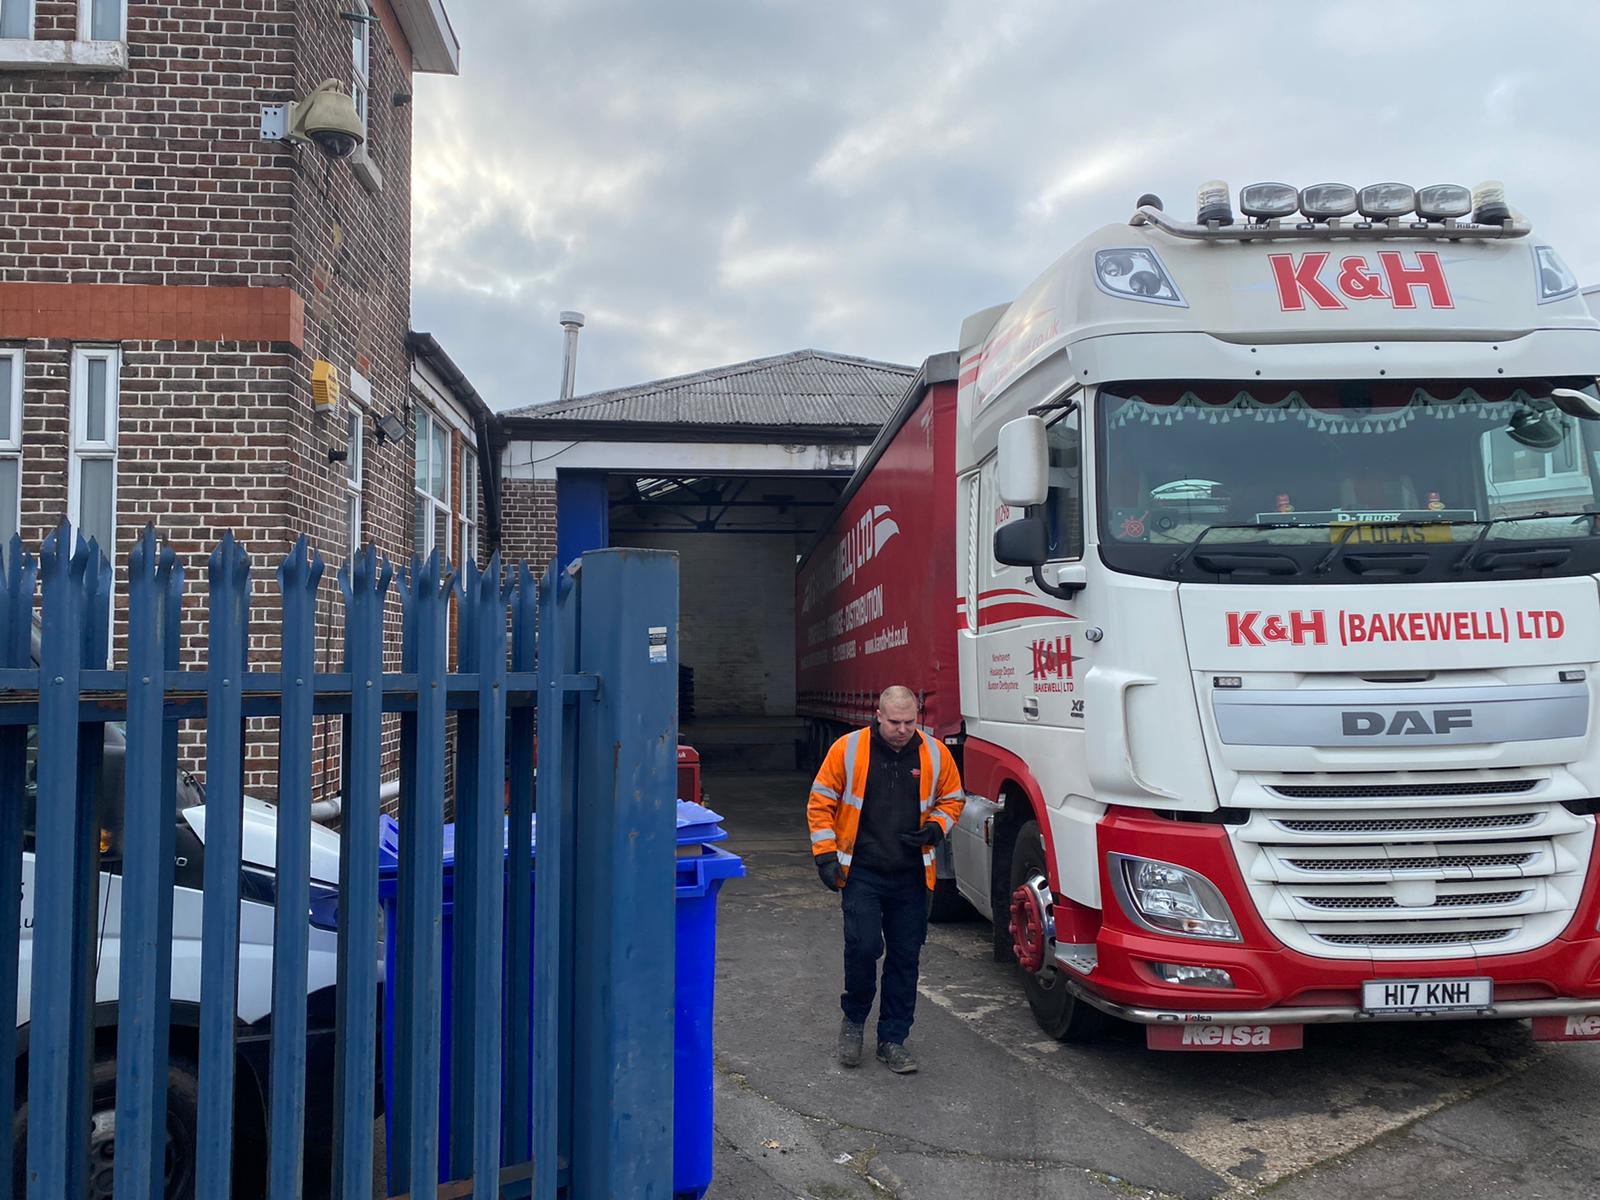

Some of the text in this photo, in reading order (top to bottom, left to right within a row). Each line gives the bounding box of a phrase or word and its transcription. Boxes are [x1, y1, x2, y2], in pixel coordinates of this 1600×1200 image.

[1267, 250, 1456, 312] K&H
[856, 508, 874, 569] LTD
[845, 583, 884, 631] DISTRIBUTION
[1225, 607, 1566, 647] K&H (BAKEWELL) LTD
[1032, 634, 1073, 681] K&H
[1063, 681, 1074, 693] LTD
[1341, 709, 1473, 736] DAF
[1384, 982, 1471, 1006] H17 KNH
[1181, 1025, 1272, 1046] Kelsa
